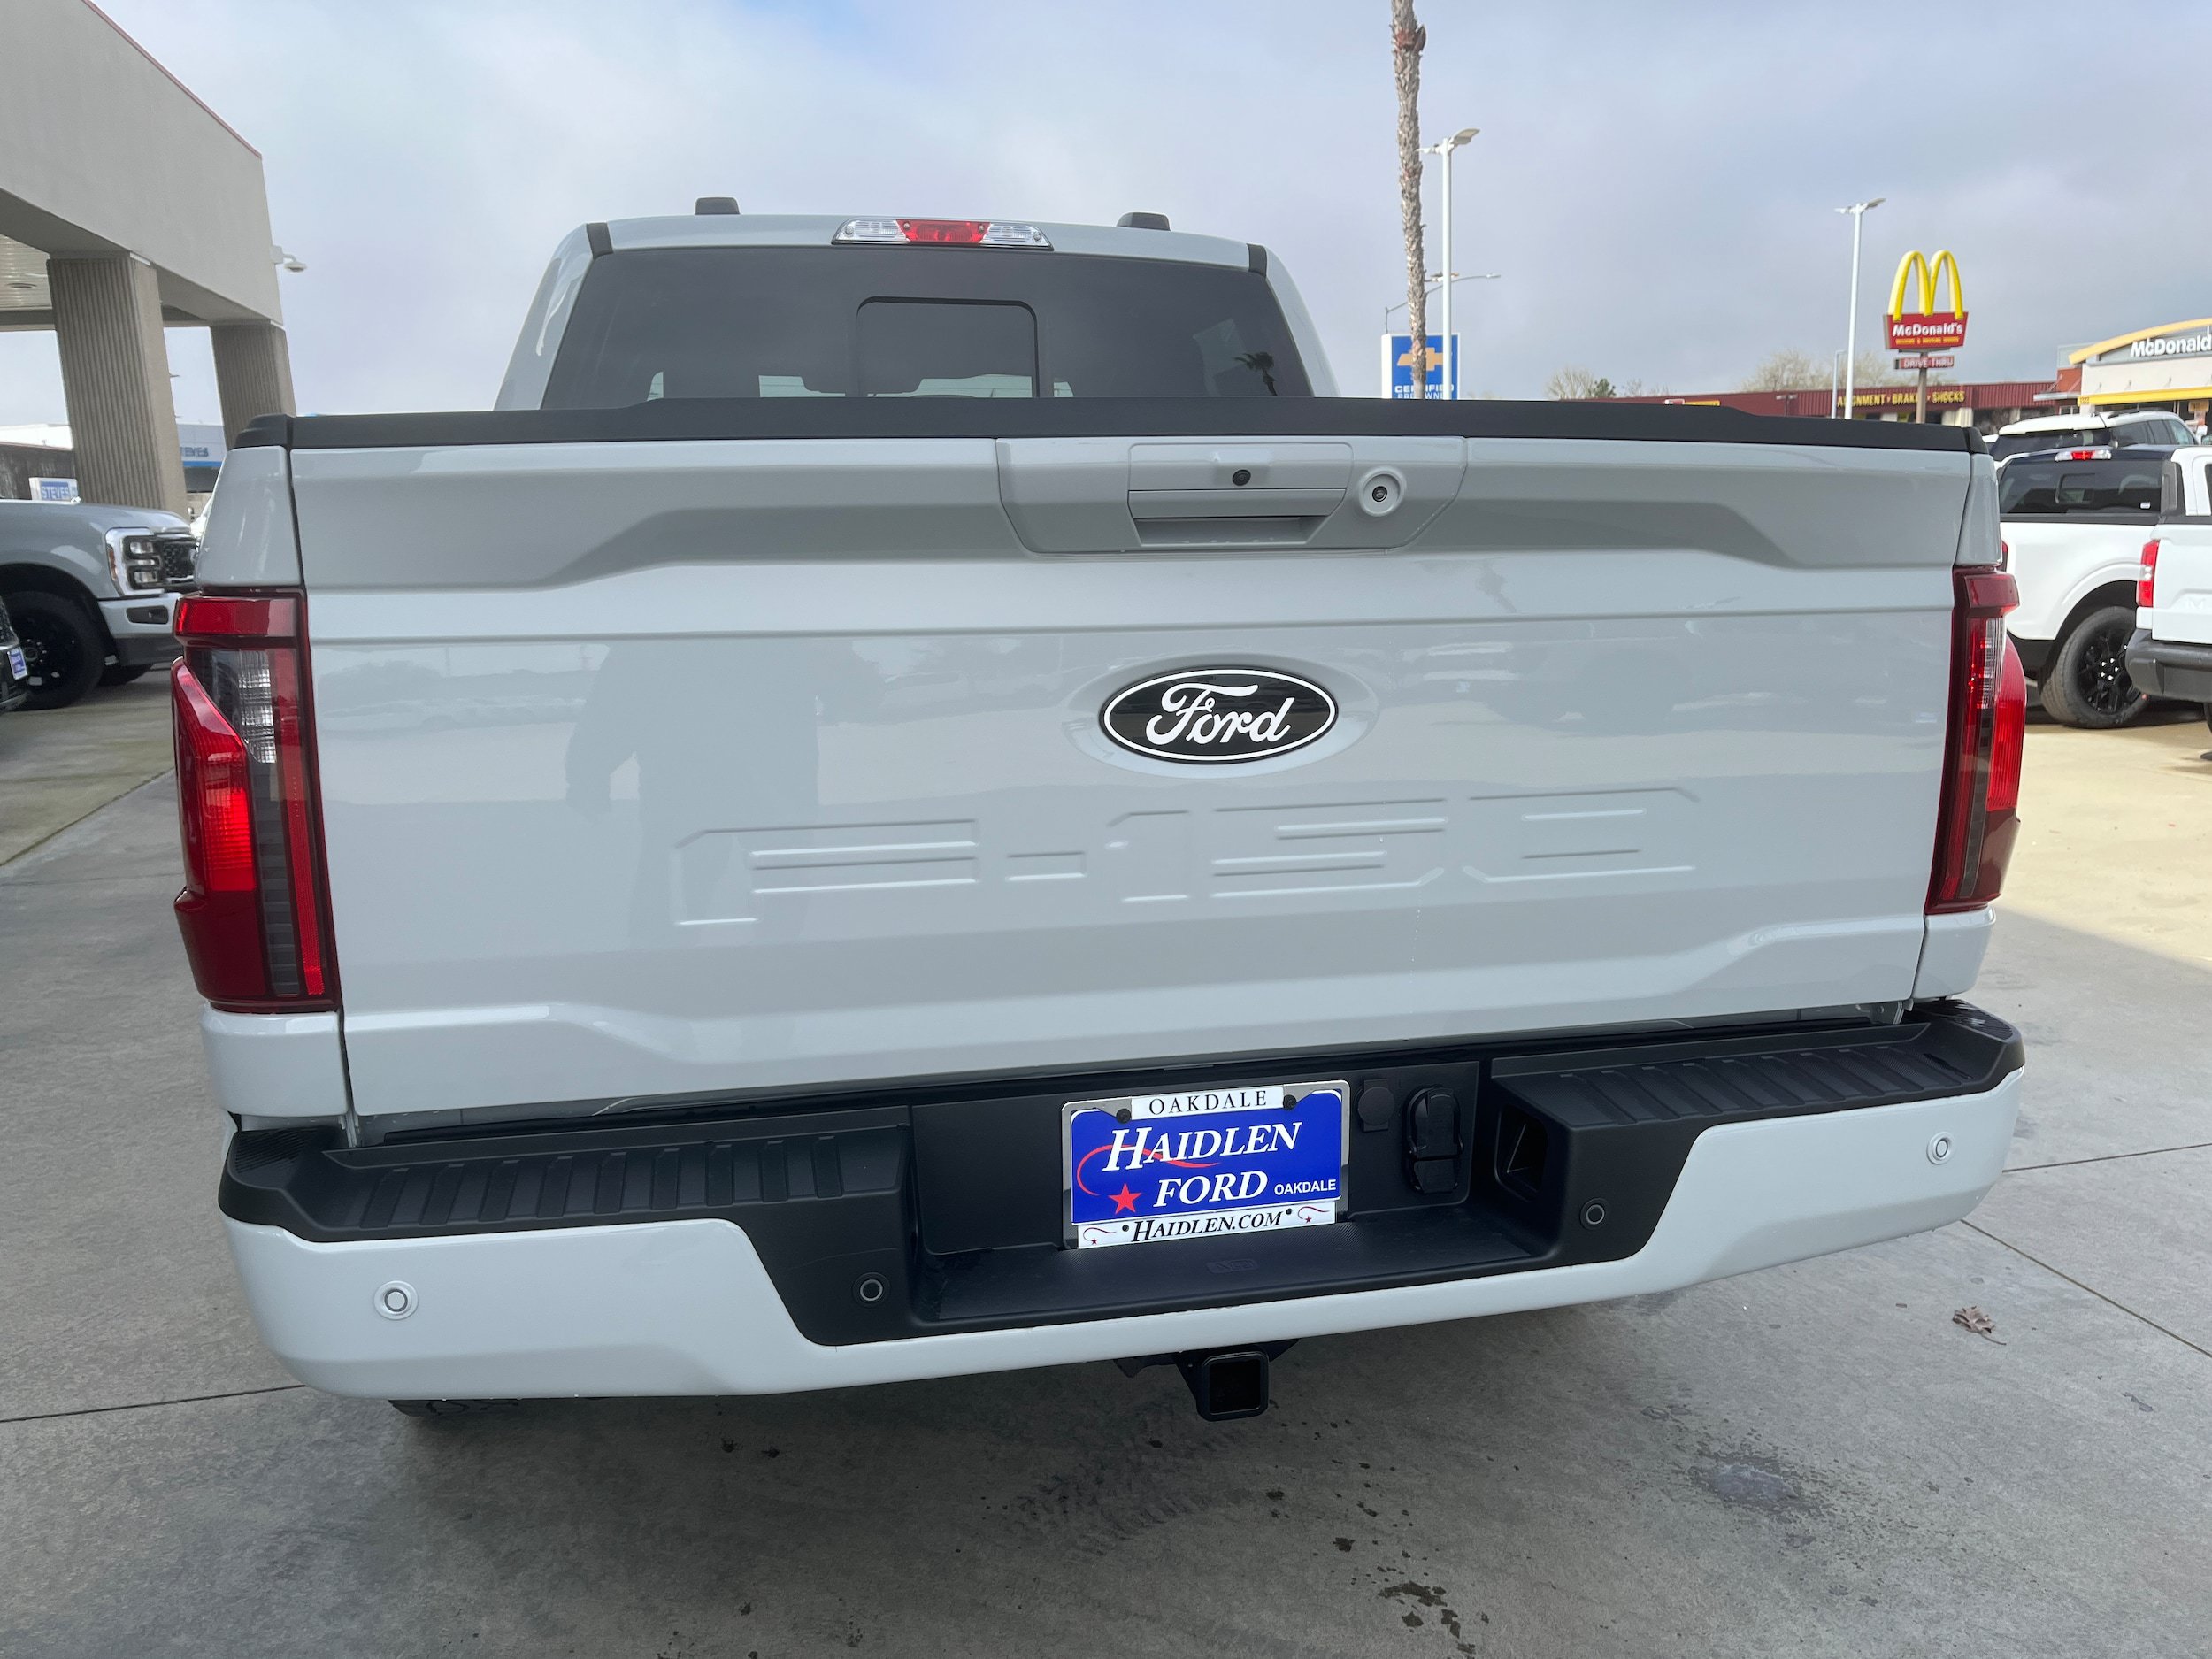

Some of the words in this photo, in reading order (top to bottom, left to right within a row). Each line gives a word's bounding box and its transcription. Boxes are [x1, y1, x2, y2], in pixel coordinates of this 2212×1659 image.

[1893, 322, 1962, 336] McDonald's
[2130, 334, 2212, 357] McDonald
[1903, 357, 1928, 369] DRIVE
[1932, 356, 1954, 368] THRU
[1838, 394, 1886, 407] AGNMENT
[1932, 391, 1964, 403] SHOCKS
[1145, 682, 1295, 745] Ford
[673, 787, 1698, 926] F-150
[1148, 1090, 1268, 1116] OAKDALE
[1102, 1121, 1303, 1172] HAIDLEN
[1152, 1171, 1269, 1208] FORD
[1273, 1179, 1337, 1196] OAKDALE
[1130, 1210, 1284, 1243] HAIDLEN.COM
